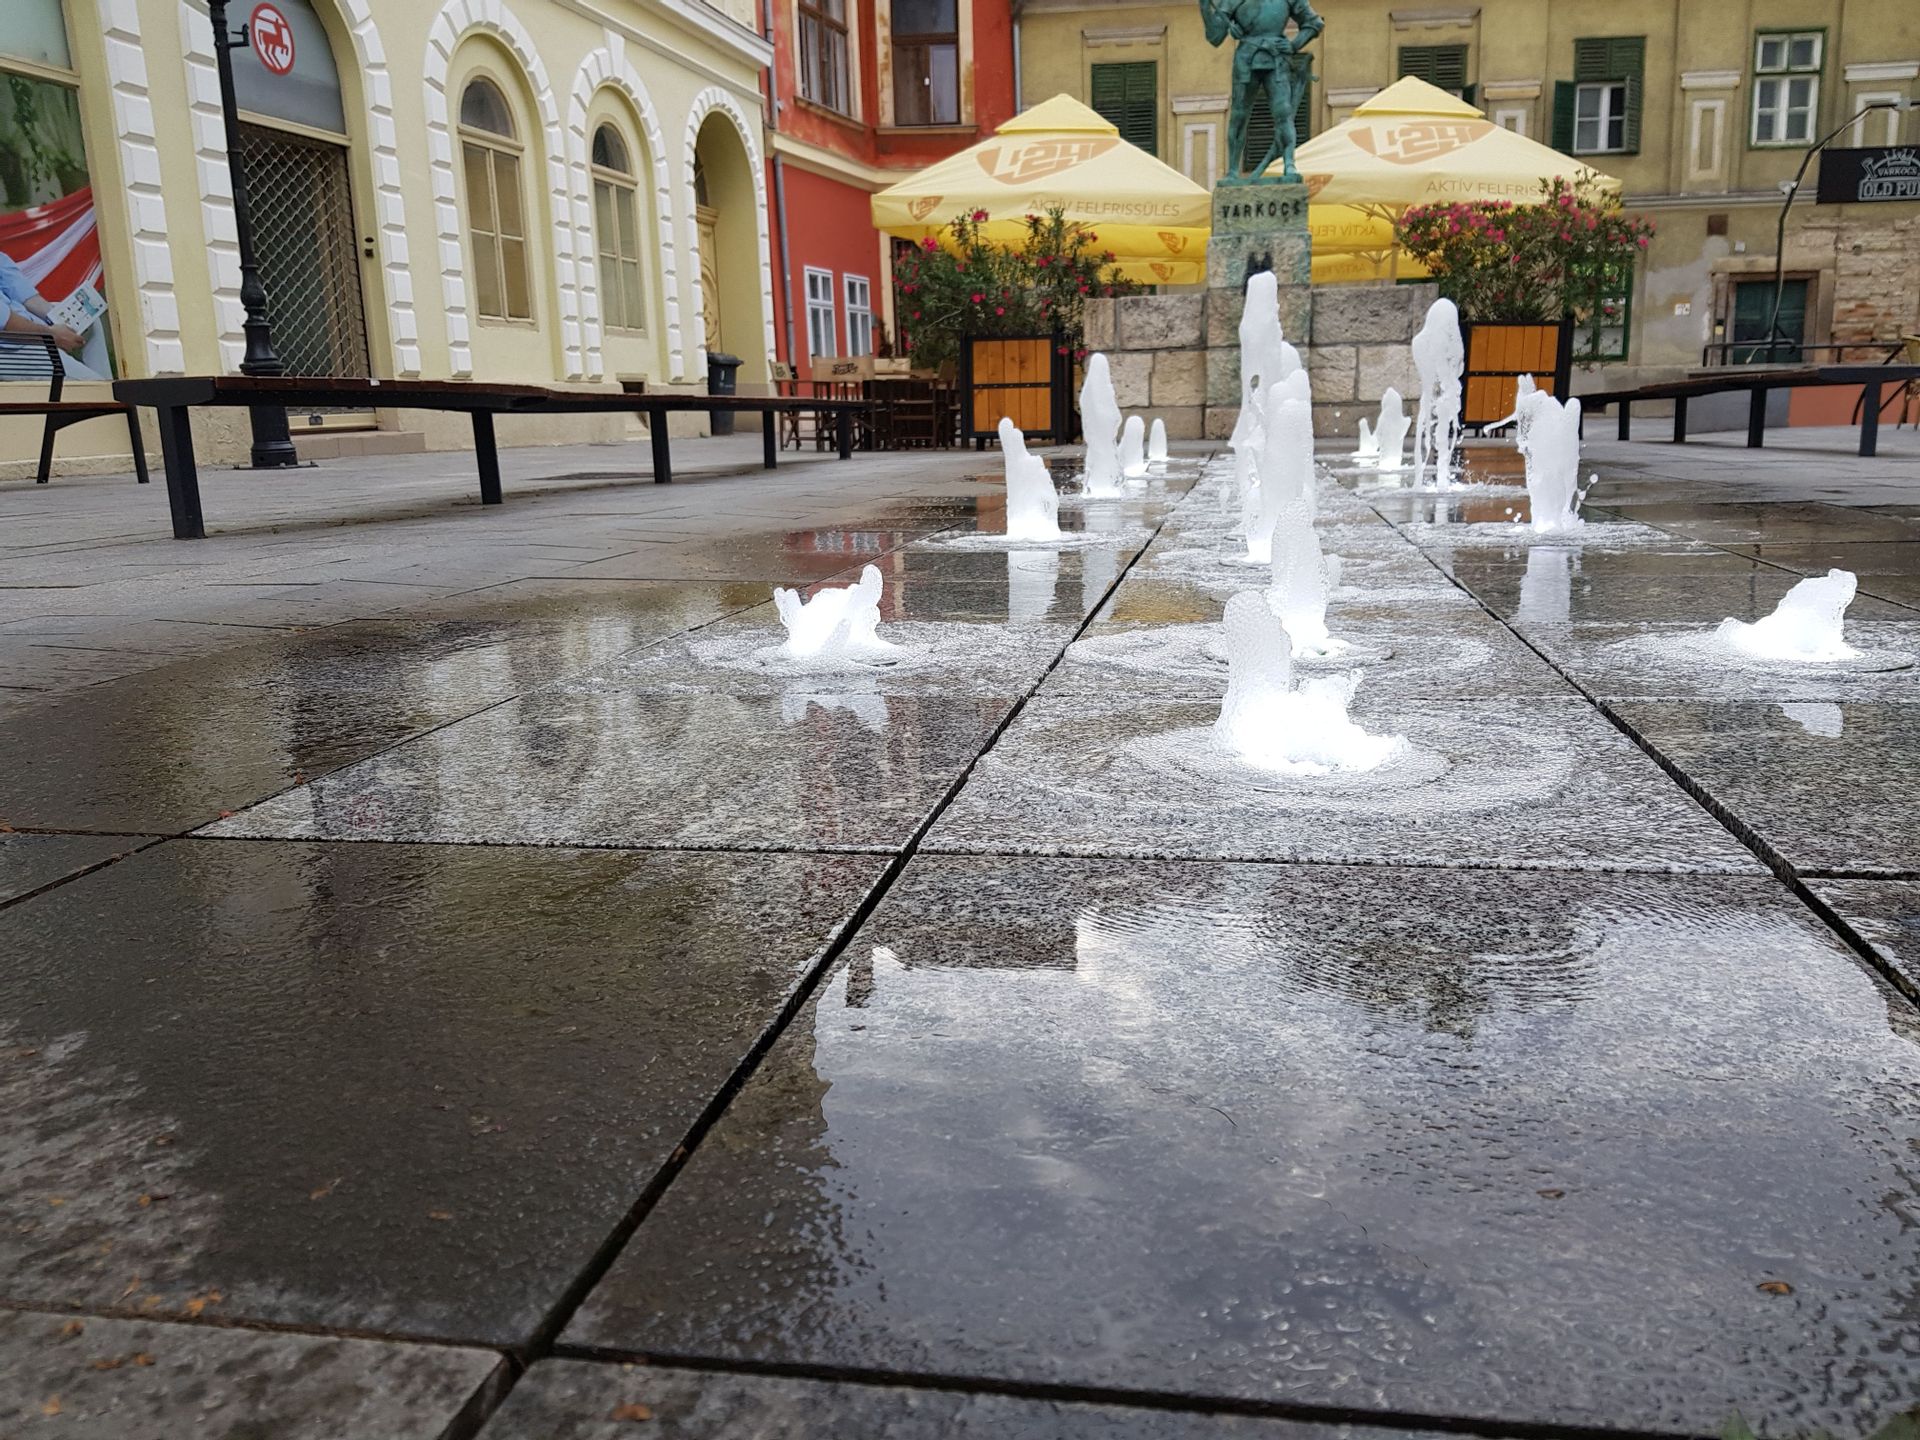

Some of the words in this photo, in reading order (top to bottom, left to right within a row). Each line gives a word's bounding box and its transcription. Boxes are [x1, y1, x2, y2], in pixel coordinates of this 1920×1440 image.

[1426, 177, 1473, 194] AKTÍV
[1863, 181, 1893, 197] OLD
[1028, 198, 1073, 211] AKTÍV
[1076, 200, 1181, 217] FELFRISSÜLÉS
[1221, 200, 1301, 219] VARKOCS
